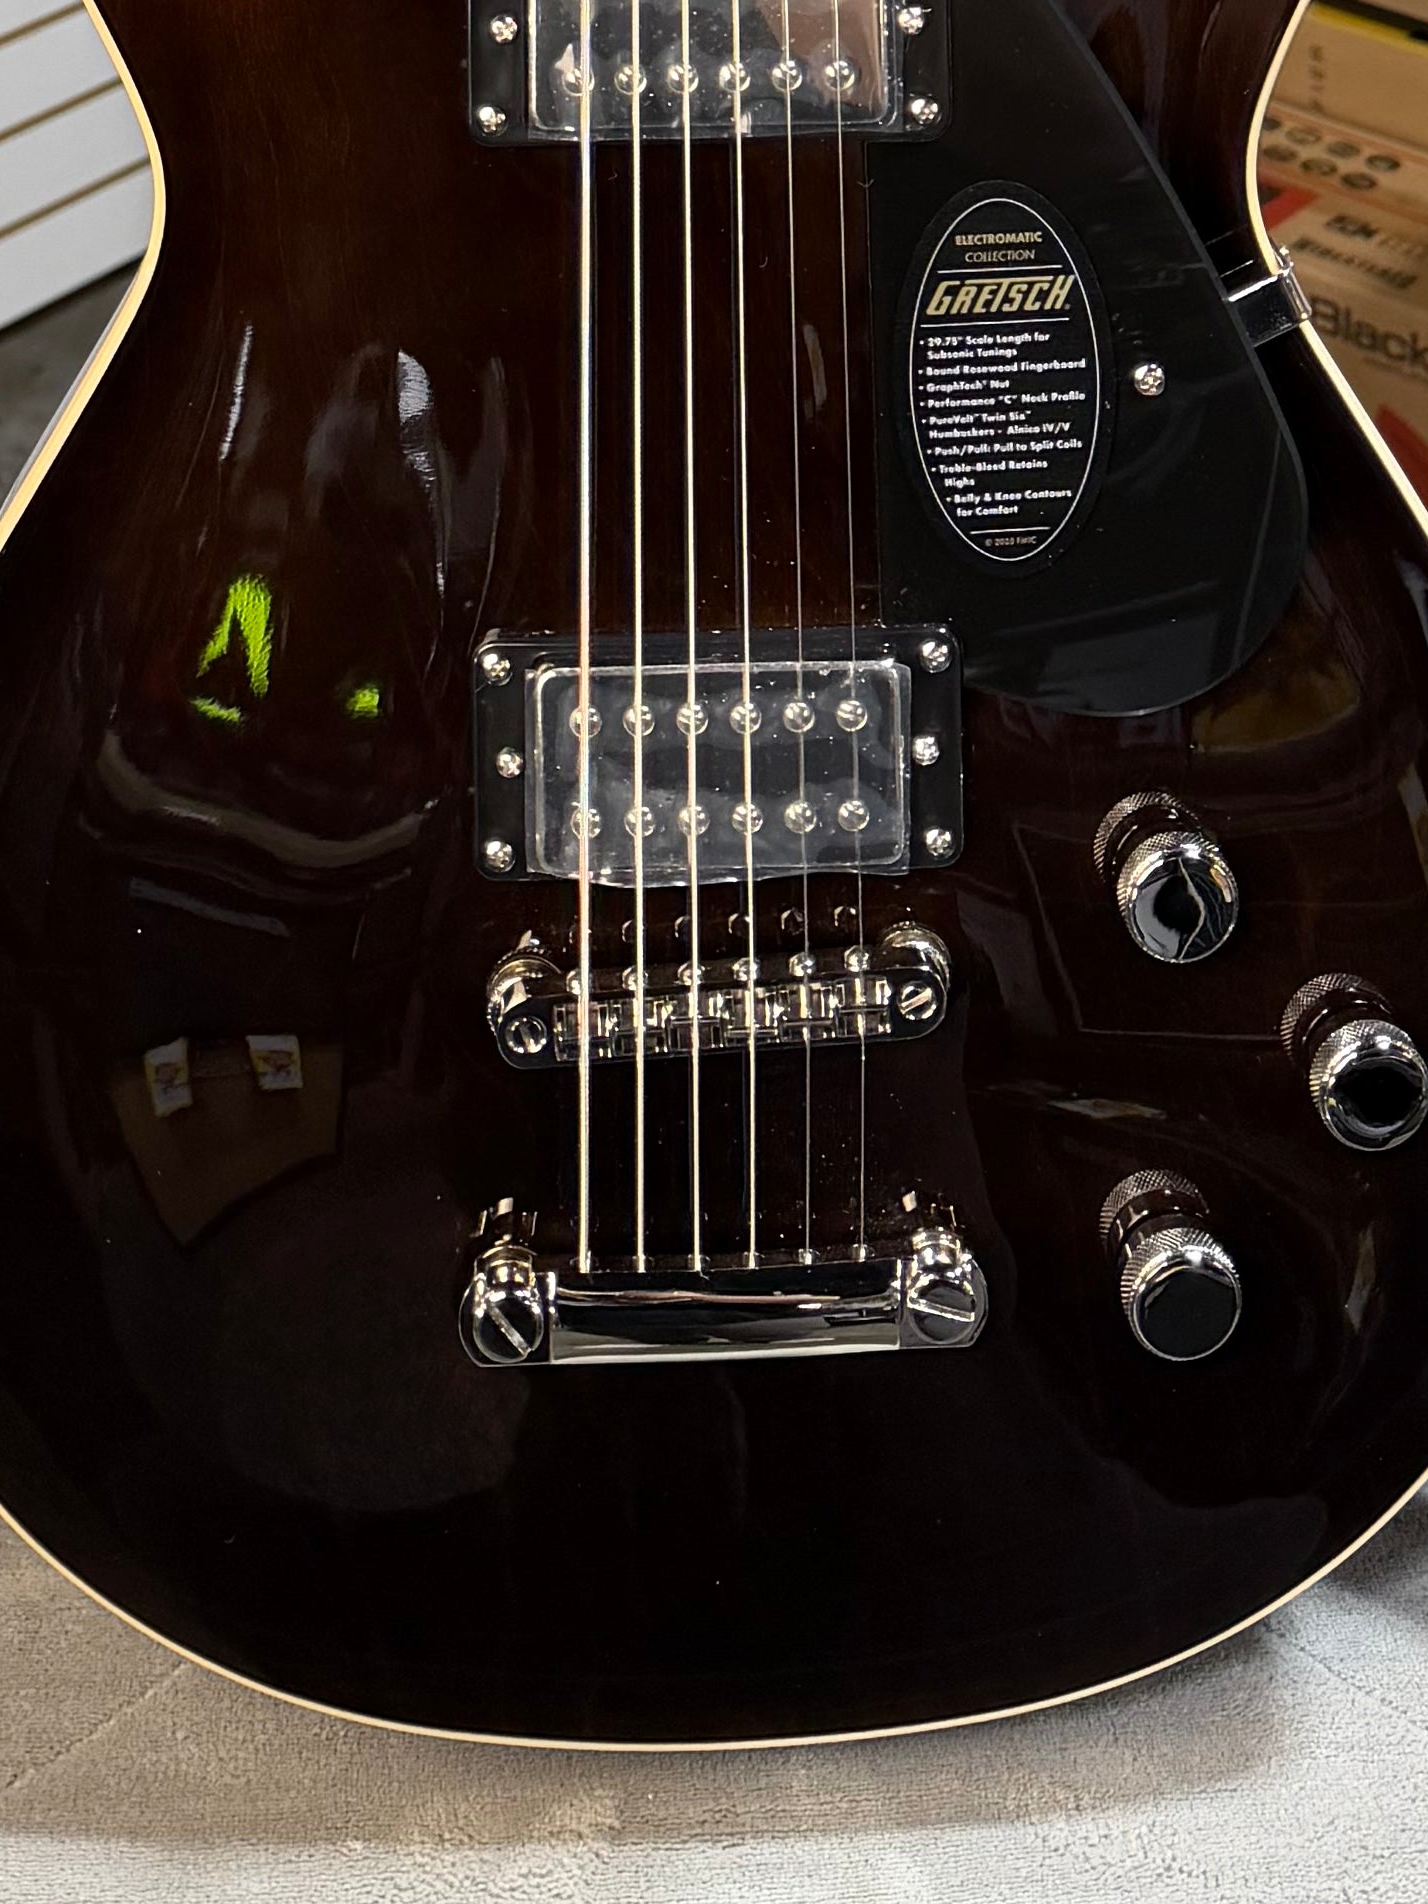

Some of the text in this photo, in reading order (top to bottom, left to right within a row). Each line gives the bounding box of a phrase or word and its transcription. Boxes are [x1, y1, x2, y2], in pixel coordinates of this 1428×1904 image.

[954, 231, 1044, 247] ELECTROMATIC
[964, 249, 1036, 263] COLLECTION
[925, 274, 1077, 316] GRETSCH
[965, 334, 994, 346] Scale
[996, 332, 1032, 346] Length
[1034, 331, 1051, 342] for
[927, 347, 1018, 360] Subsonic Tunings
[926, 358, 1087, 376] Bound Rosewood Fingerboard
[989, 379, 1011, 389] Nut
[927, 396, 996, 409] Performance
[1021, 393, 1049, 404] Neck
[1051, 391, 1086, 402] Profile
[1042, 422, 1072, 435] IV/V
[1056, 438, 1083, 450] Coils
[1023, 489, 1073, 500] Contours
[956, 505, 1019, 518] for Comfort
